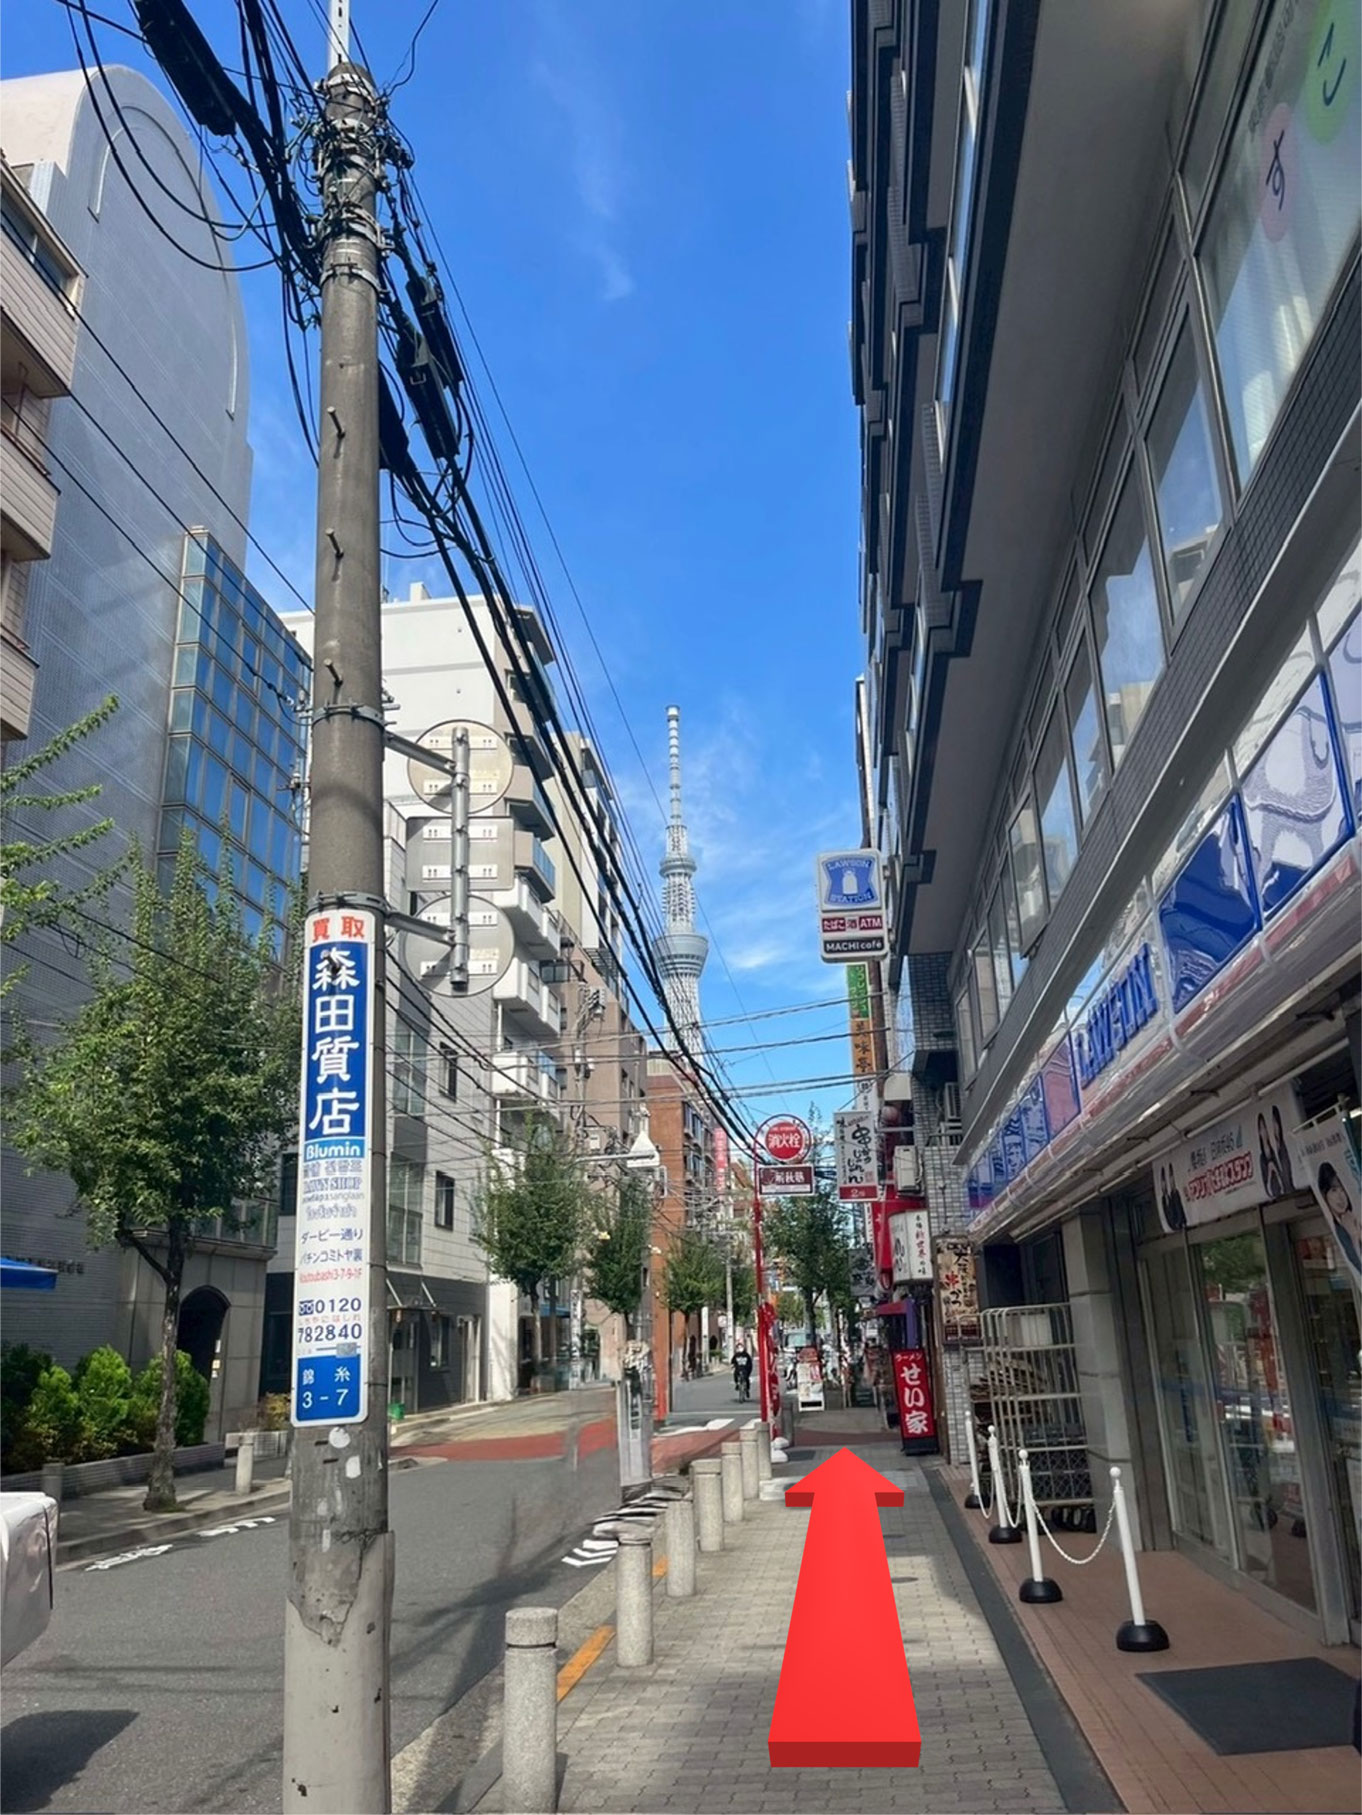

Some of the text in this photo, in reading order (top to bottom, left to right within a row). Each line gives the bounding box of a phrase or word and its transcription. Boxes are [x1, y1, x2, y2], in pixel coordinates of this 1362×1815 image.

[312, 915, 364, 942] 買取
[860, 917, 881, 928] ATM
[309, 947, 360, 1135] 森田質店
[306, 1142, 360, 1160] Blumin
[767, 1134, 801, 1149] 消火栓
[301, 1228, 363, 1244] ダービー通り
[315, 1297, 362, 1314] 0120
[297, 1323, 362, 1343] 782840
[302, 1366, 350, 1385] 錦糸
[302, 1388, 349, 1408] 3-7
[901, 1363, 928, 1434] せい家
